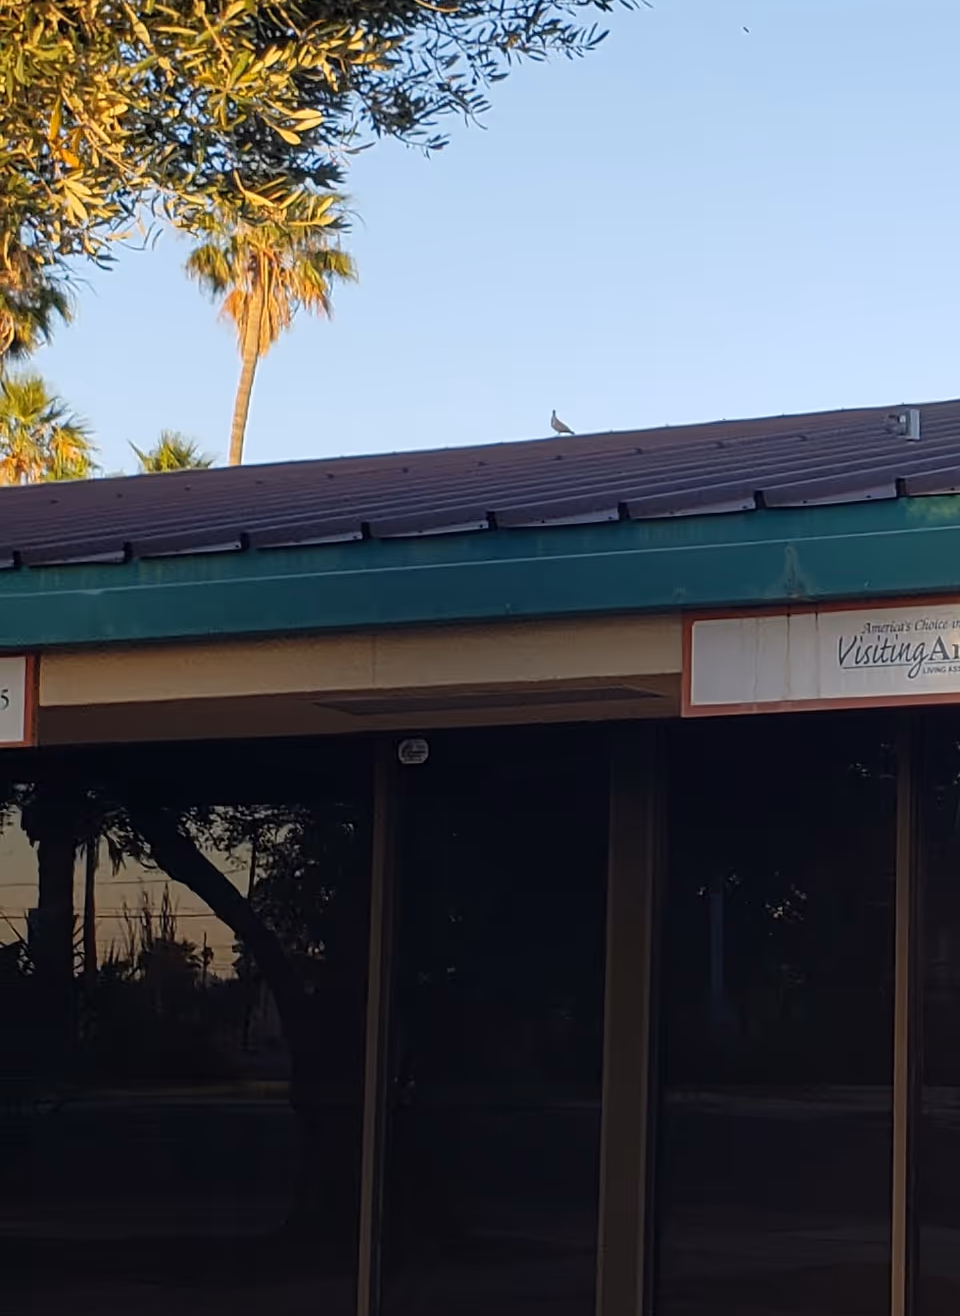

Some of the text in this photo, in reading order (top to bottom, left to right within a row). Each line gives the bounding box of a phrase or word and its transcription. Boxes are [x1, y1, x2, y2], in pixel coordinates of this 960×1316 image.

[862, 618, 911, 634] America's
[914, 617, 949, 632] Choice
[922, 664, 948, 675] LIVING
